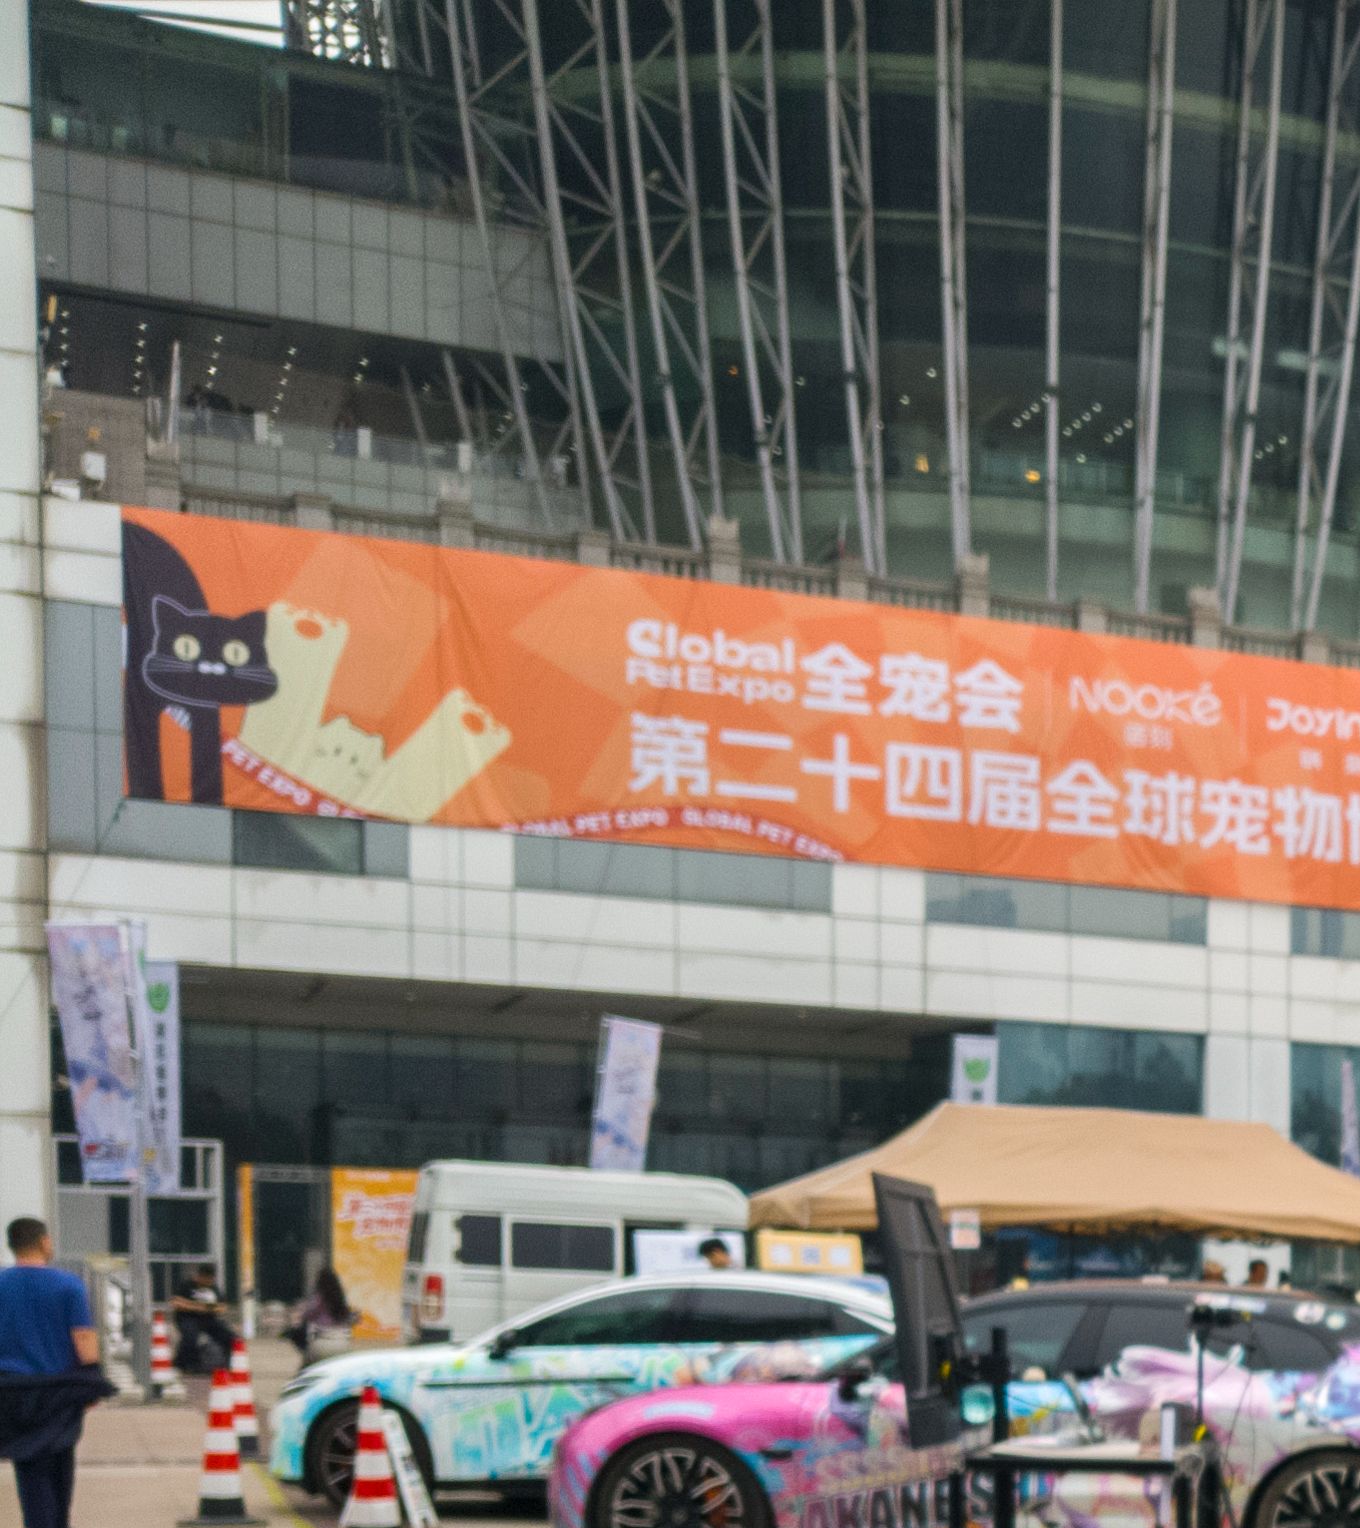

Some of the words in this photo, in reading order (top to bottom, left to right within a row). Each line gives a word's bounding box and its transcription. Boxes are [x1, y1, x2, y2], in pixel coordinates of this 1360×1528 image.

[803, 643, 1023, 732] 全宠会
[256, 766, 312, 806] EXPO
